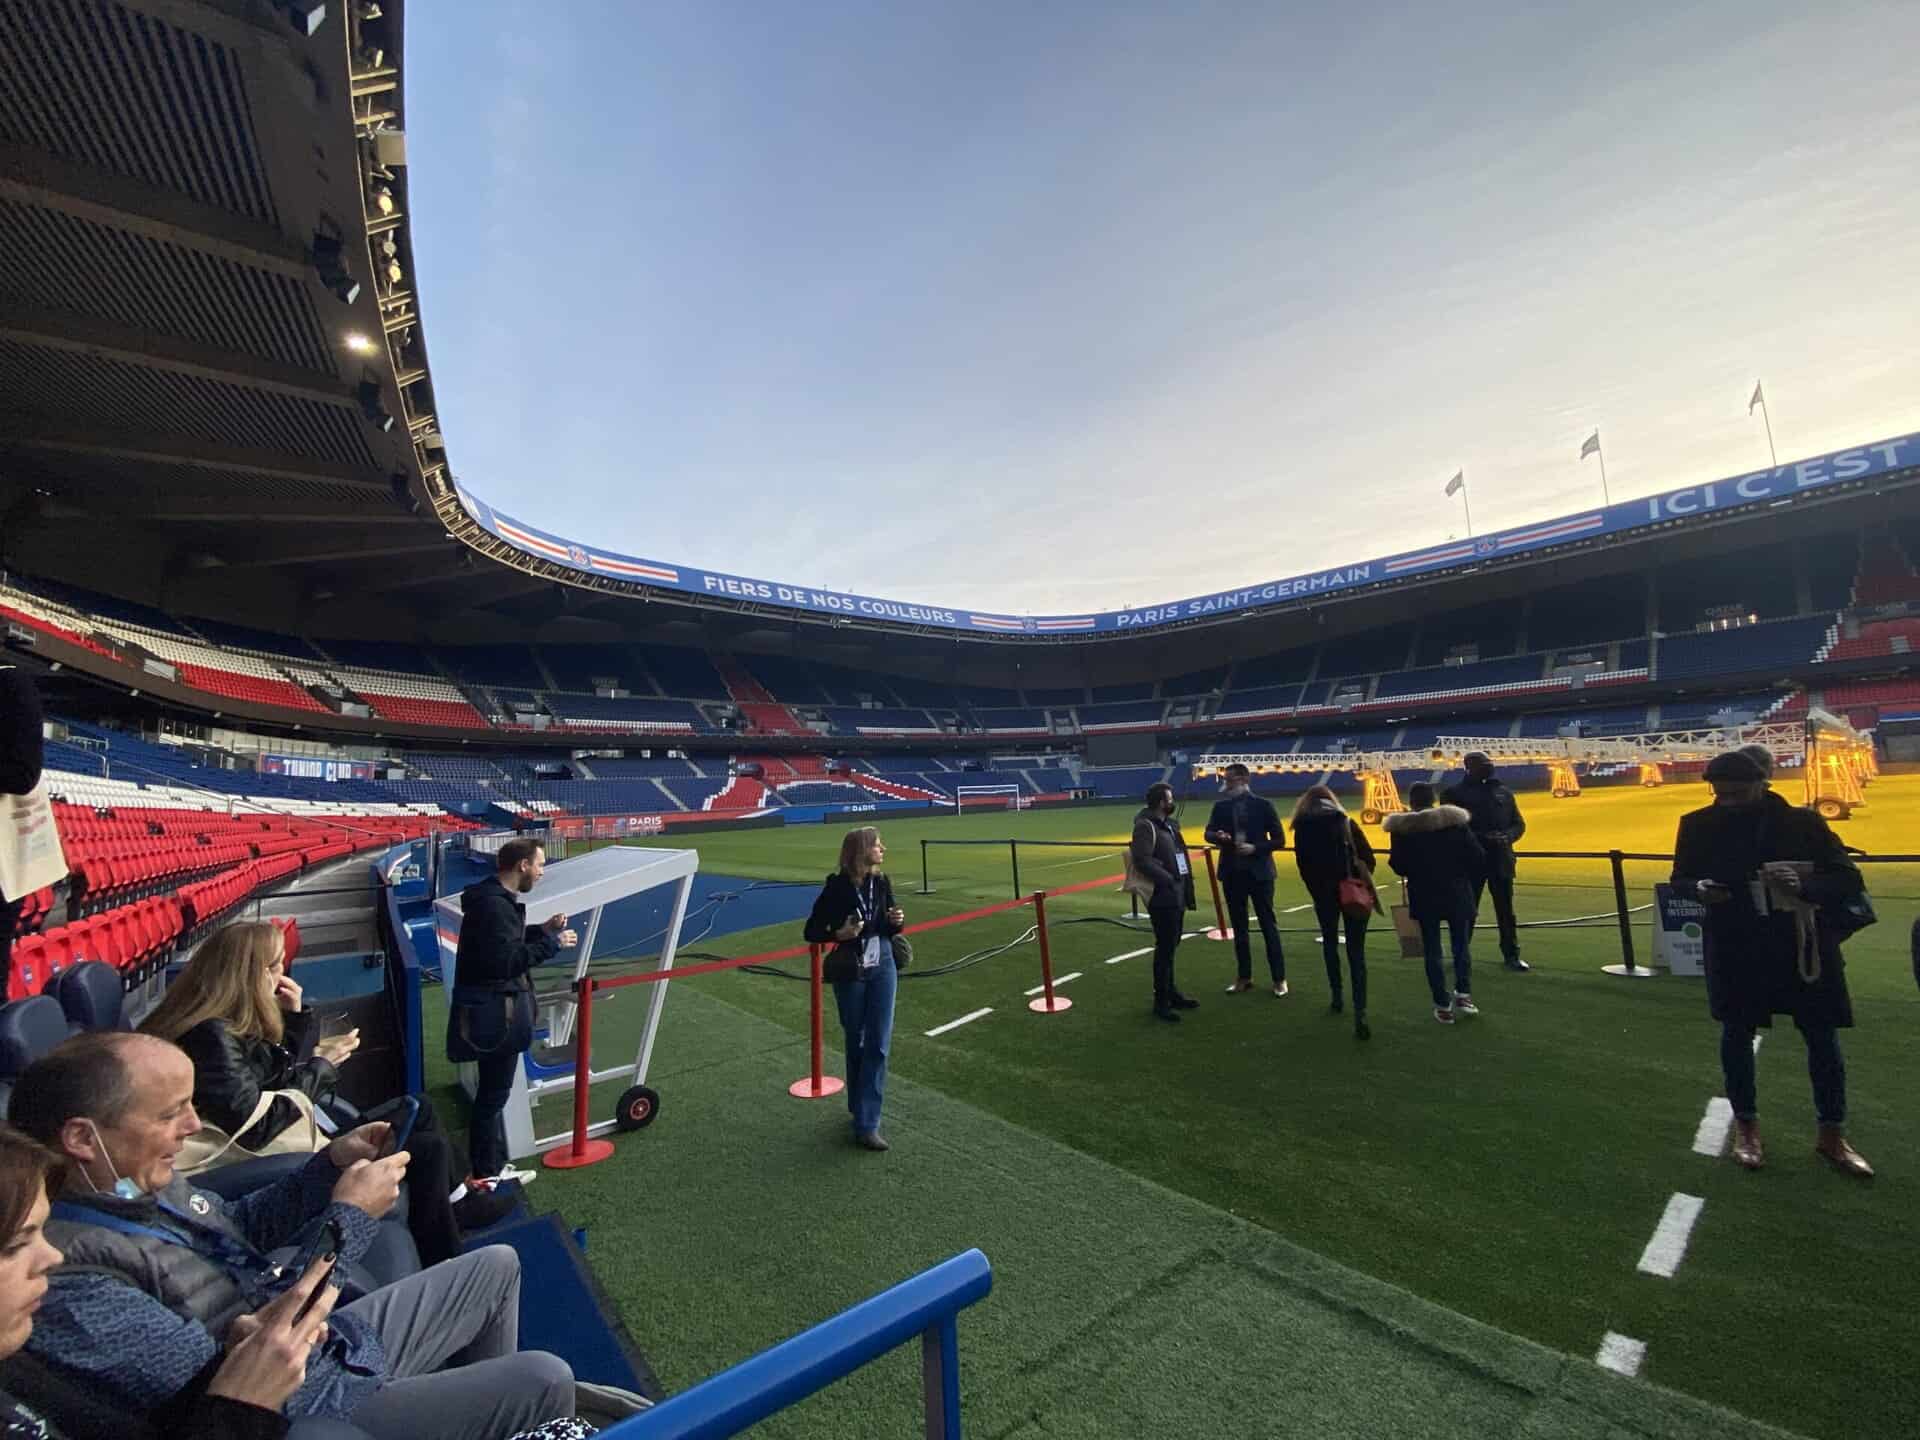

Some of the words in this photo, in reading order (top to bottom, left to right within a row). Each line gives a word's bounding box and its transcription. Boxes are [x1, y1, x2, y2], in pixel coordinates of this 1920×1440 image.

[1648, 484, 1716, 519] ICI
[1735, 439, 1909, 497] C'EST
[703, 575, 773, 599] FIERS
[777, 587, 808, 604] DE
[812, 593, 855, 611] NOS
[860, 600, 956, 624] COULEURS
[1116, 606, 1179, 627] PARIS
[1187, 565, 1371, 615] SAINT-GERMAIN
[629, 816, 663, 825] PARIS
